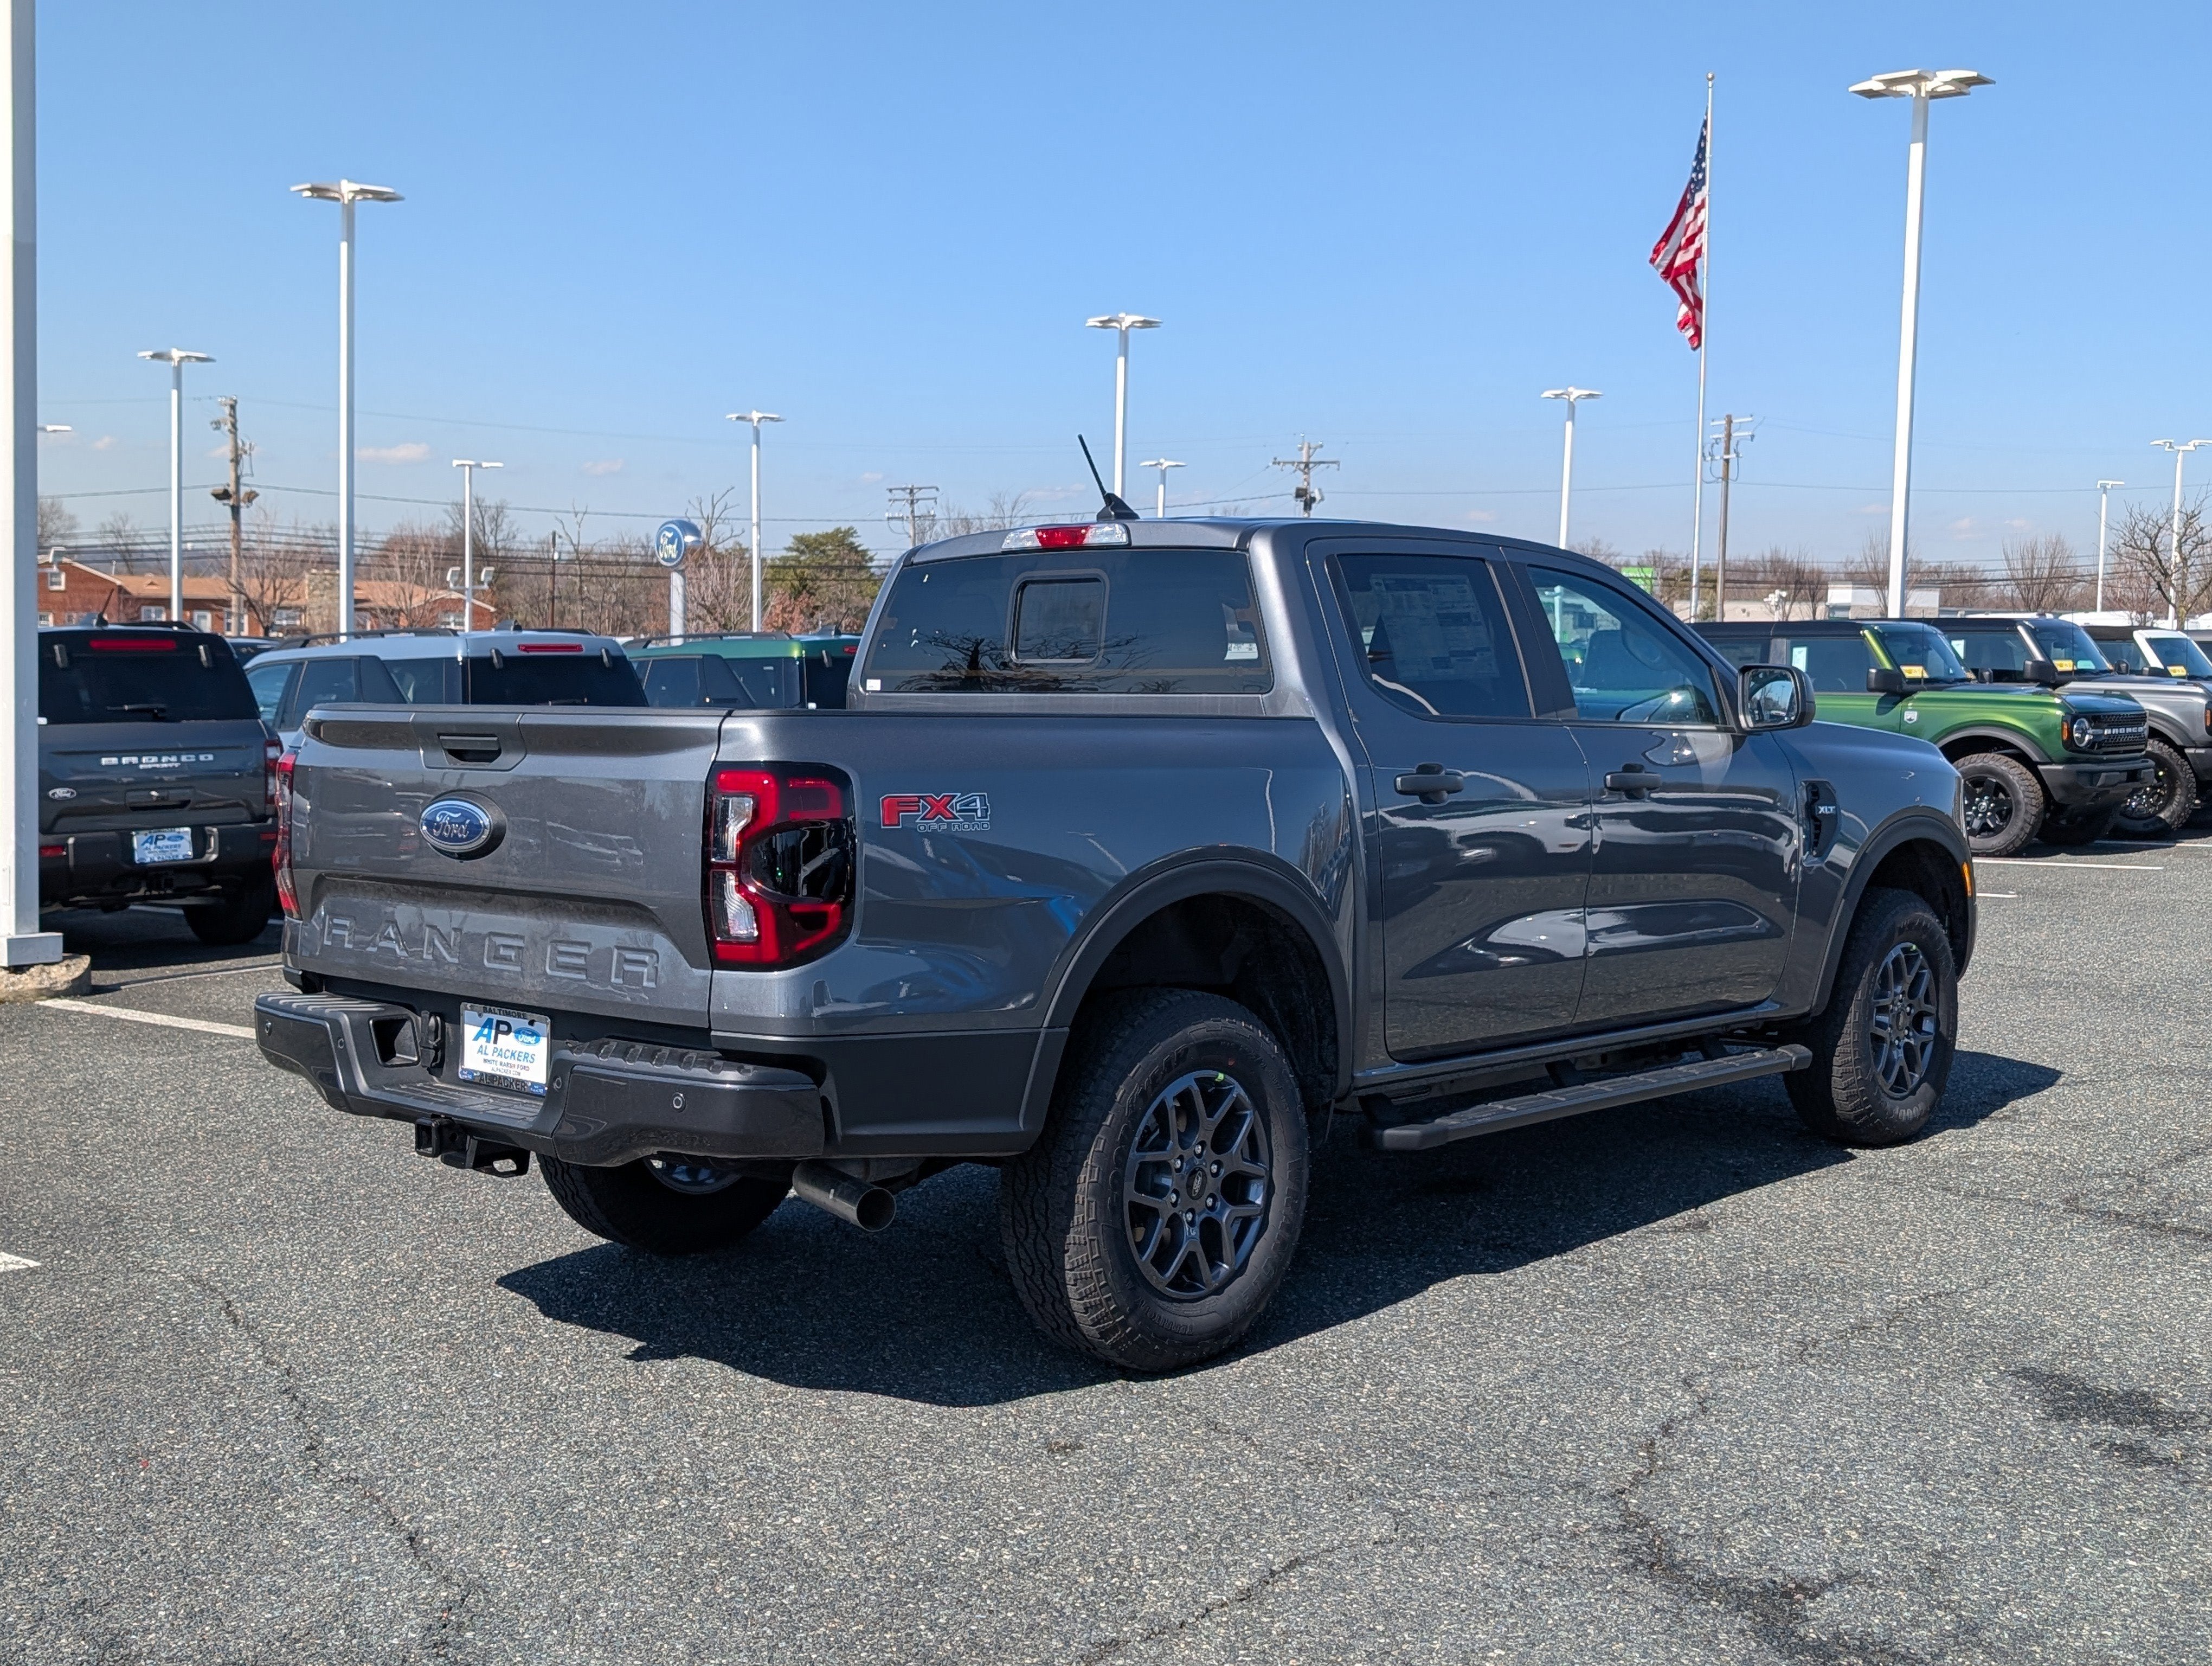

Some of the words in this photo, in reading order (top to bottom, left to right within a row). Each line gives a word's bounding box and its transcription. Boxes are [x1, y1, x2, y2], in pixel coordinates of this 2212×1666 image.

[659, 531, 678, 559] Ford
[101, 754, 214, 766] BRONCO
[880, 793, 990, 829] FX4
[1817, 805, 1836, 814] XLT
[433, 810, 471, 838] Ford
[917, 822, 947, 832] OFF
[951, 822, 990, 831] ROAD
[140, 835, 166, 846] AP
[323, 913, 660, 988] RANGER
[483, 1007, 527, 1020] BALTIMORE
[472, 1017, 512, 1045] AP
[477, 1045, 489, 1056] AL
[491, 1047, 536, 1063] PACKERS
[479, 1073, 491, 1084] AL
[492, 1075, 527, 1092] PACKER
